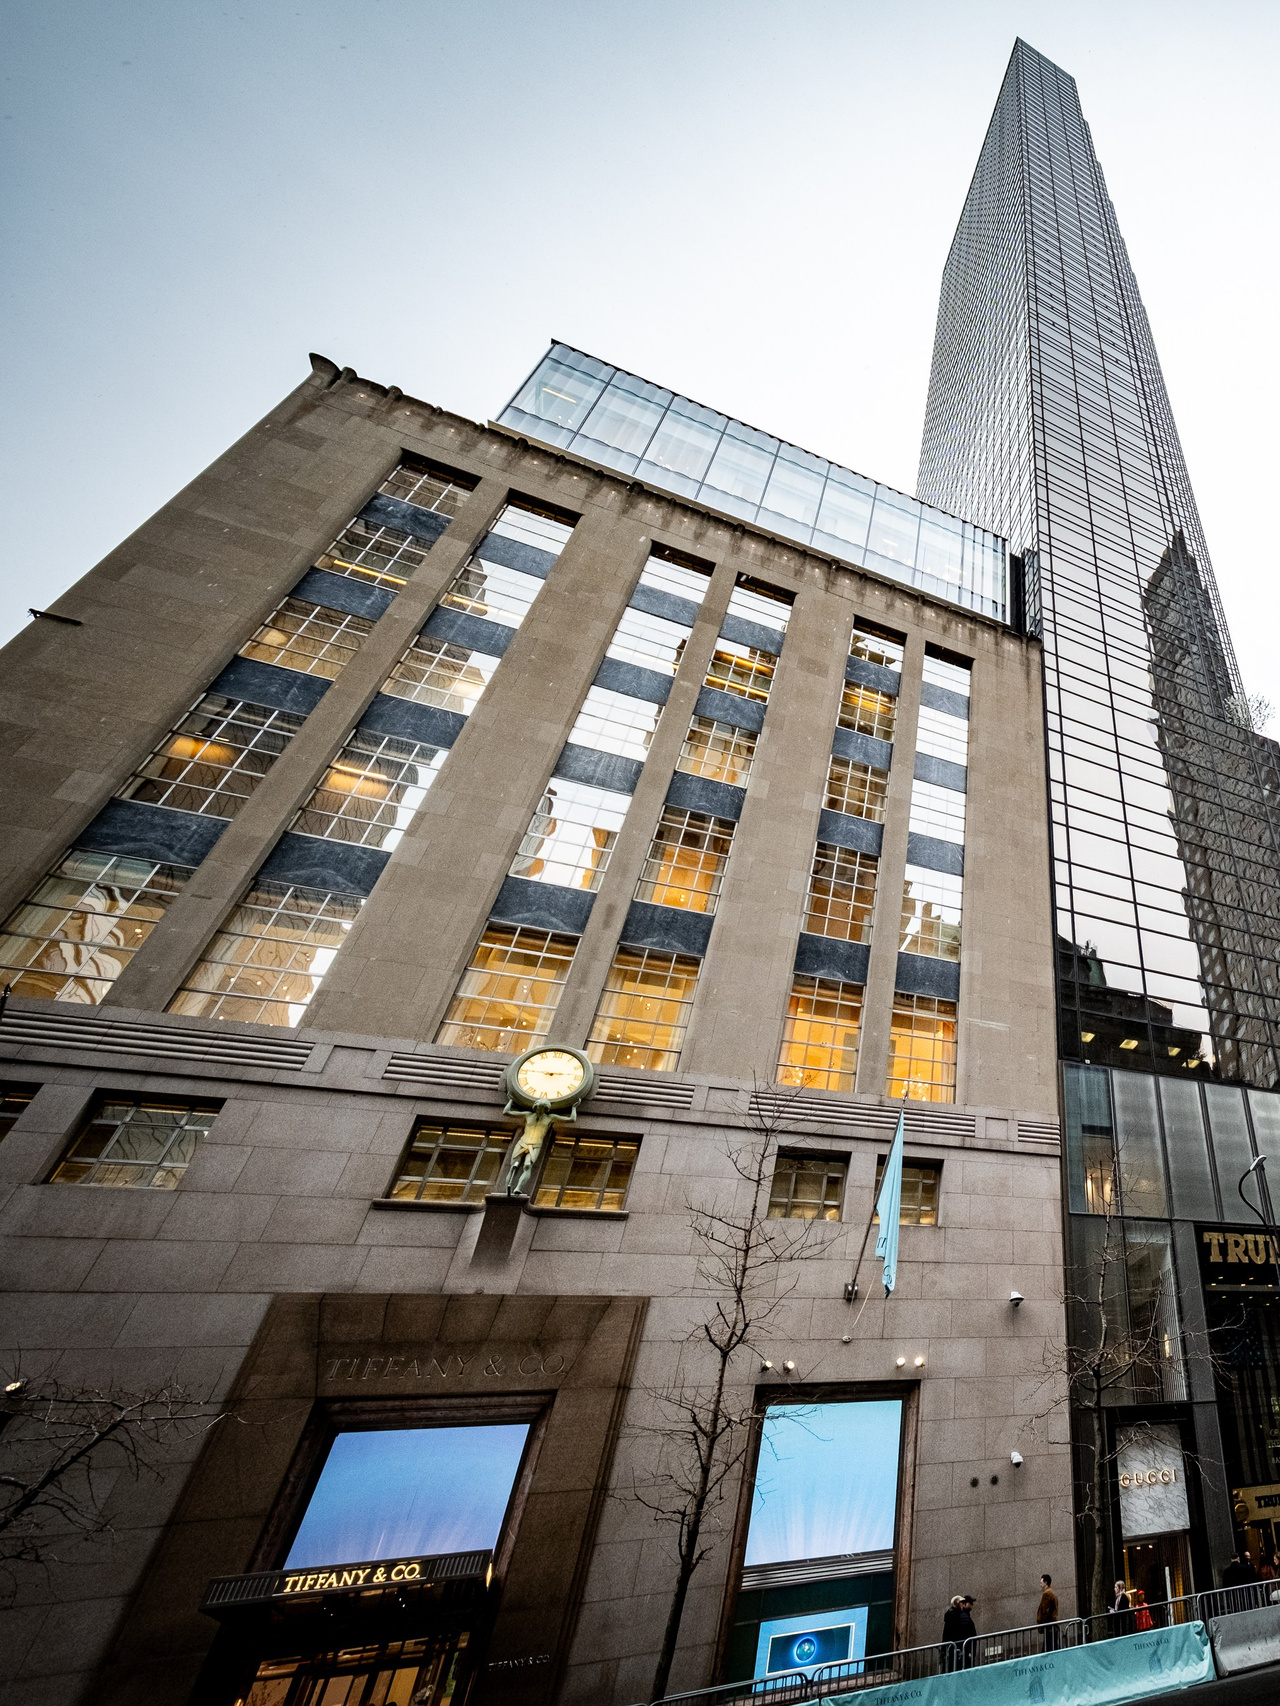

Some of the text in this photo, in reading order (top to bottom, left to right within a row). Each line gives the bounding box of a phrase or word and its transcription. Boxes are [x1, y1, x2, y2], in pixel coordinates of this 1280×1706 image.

[327, 1354, 474, 1380] TIFFANY
[484, 1355, 502, 1376] &
[1120, 1468, 1177, 1487] GUCCI
[283, 1563, 421, 1593] TIFFANY & CO.
[875, 1693, 903, 1706] TIFFANY
[904, 1692, 909, 1700] &
